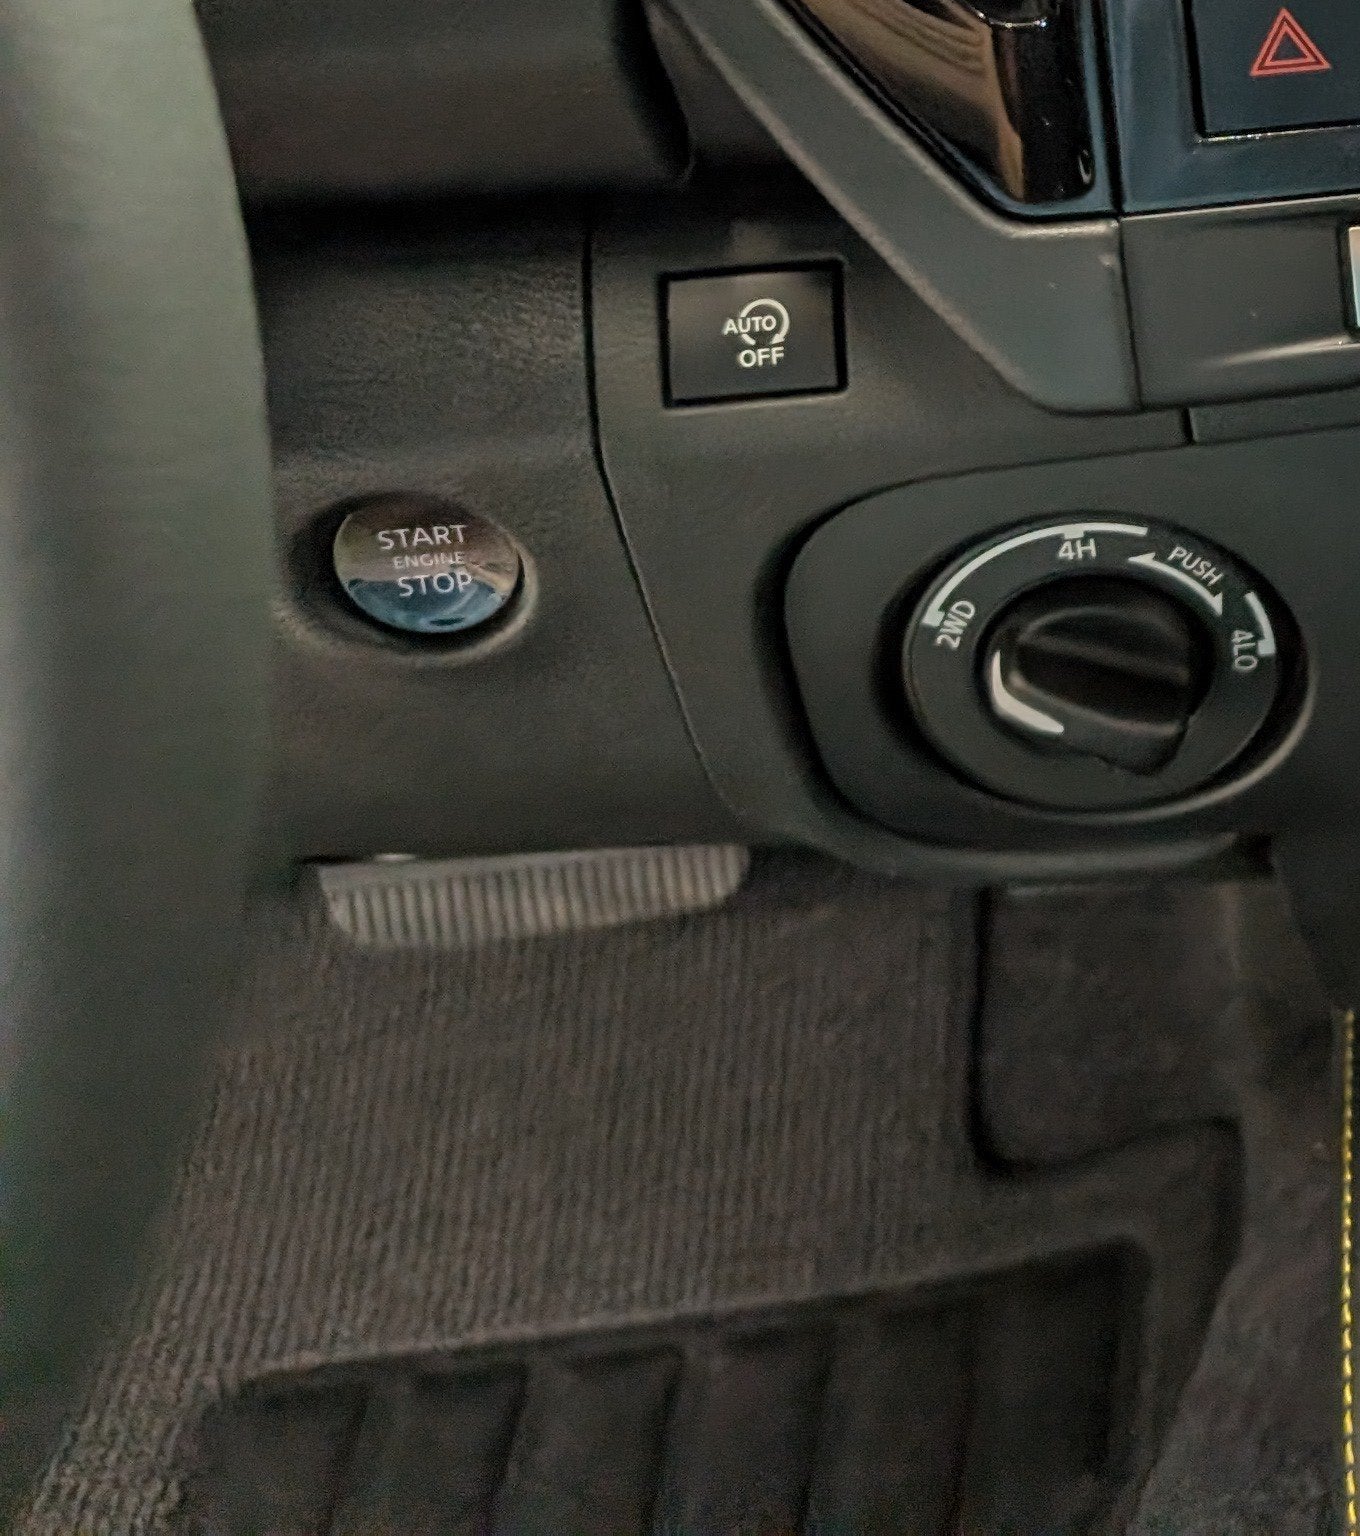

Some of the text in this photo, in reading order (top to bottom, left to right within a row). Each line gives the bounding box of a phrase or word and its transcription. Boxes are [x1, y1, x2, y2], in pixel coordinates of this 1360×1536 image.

[723, 314, 776, 337] AUTO
[737, 347, 785, 368] OFF
[377, 524, 468, 551] START
[1057, 539, 1097, 561] 4H
[392, 549, 466, 571] ENGINE
[1166, 545, 1225, 587] PUSH
[397, 570, 473, 598] STOP
[934, 599, 976, 649] 2WD
[1230, 628, 1259, 674] 4LO
